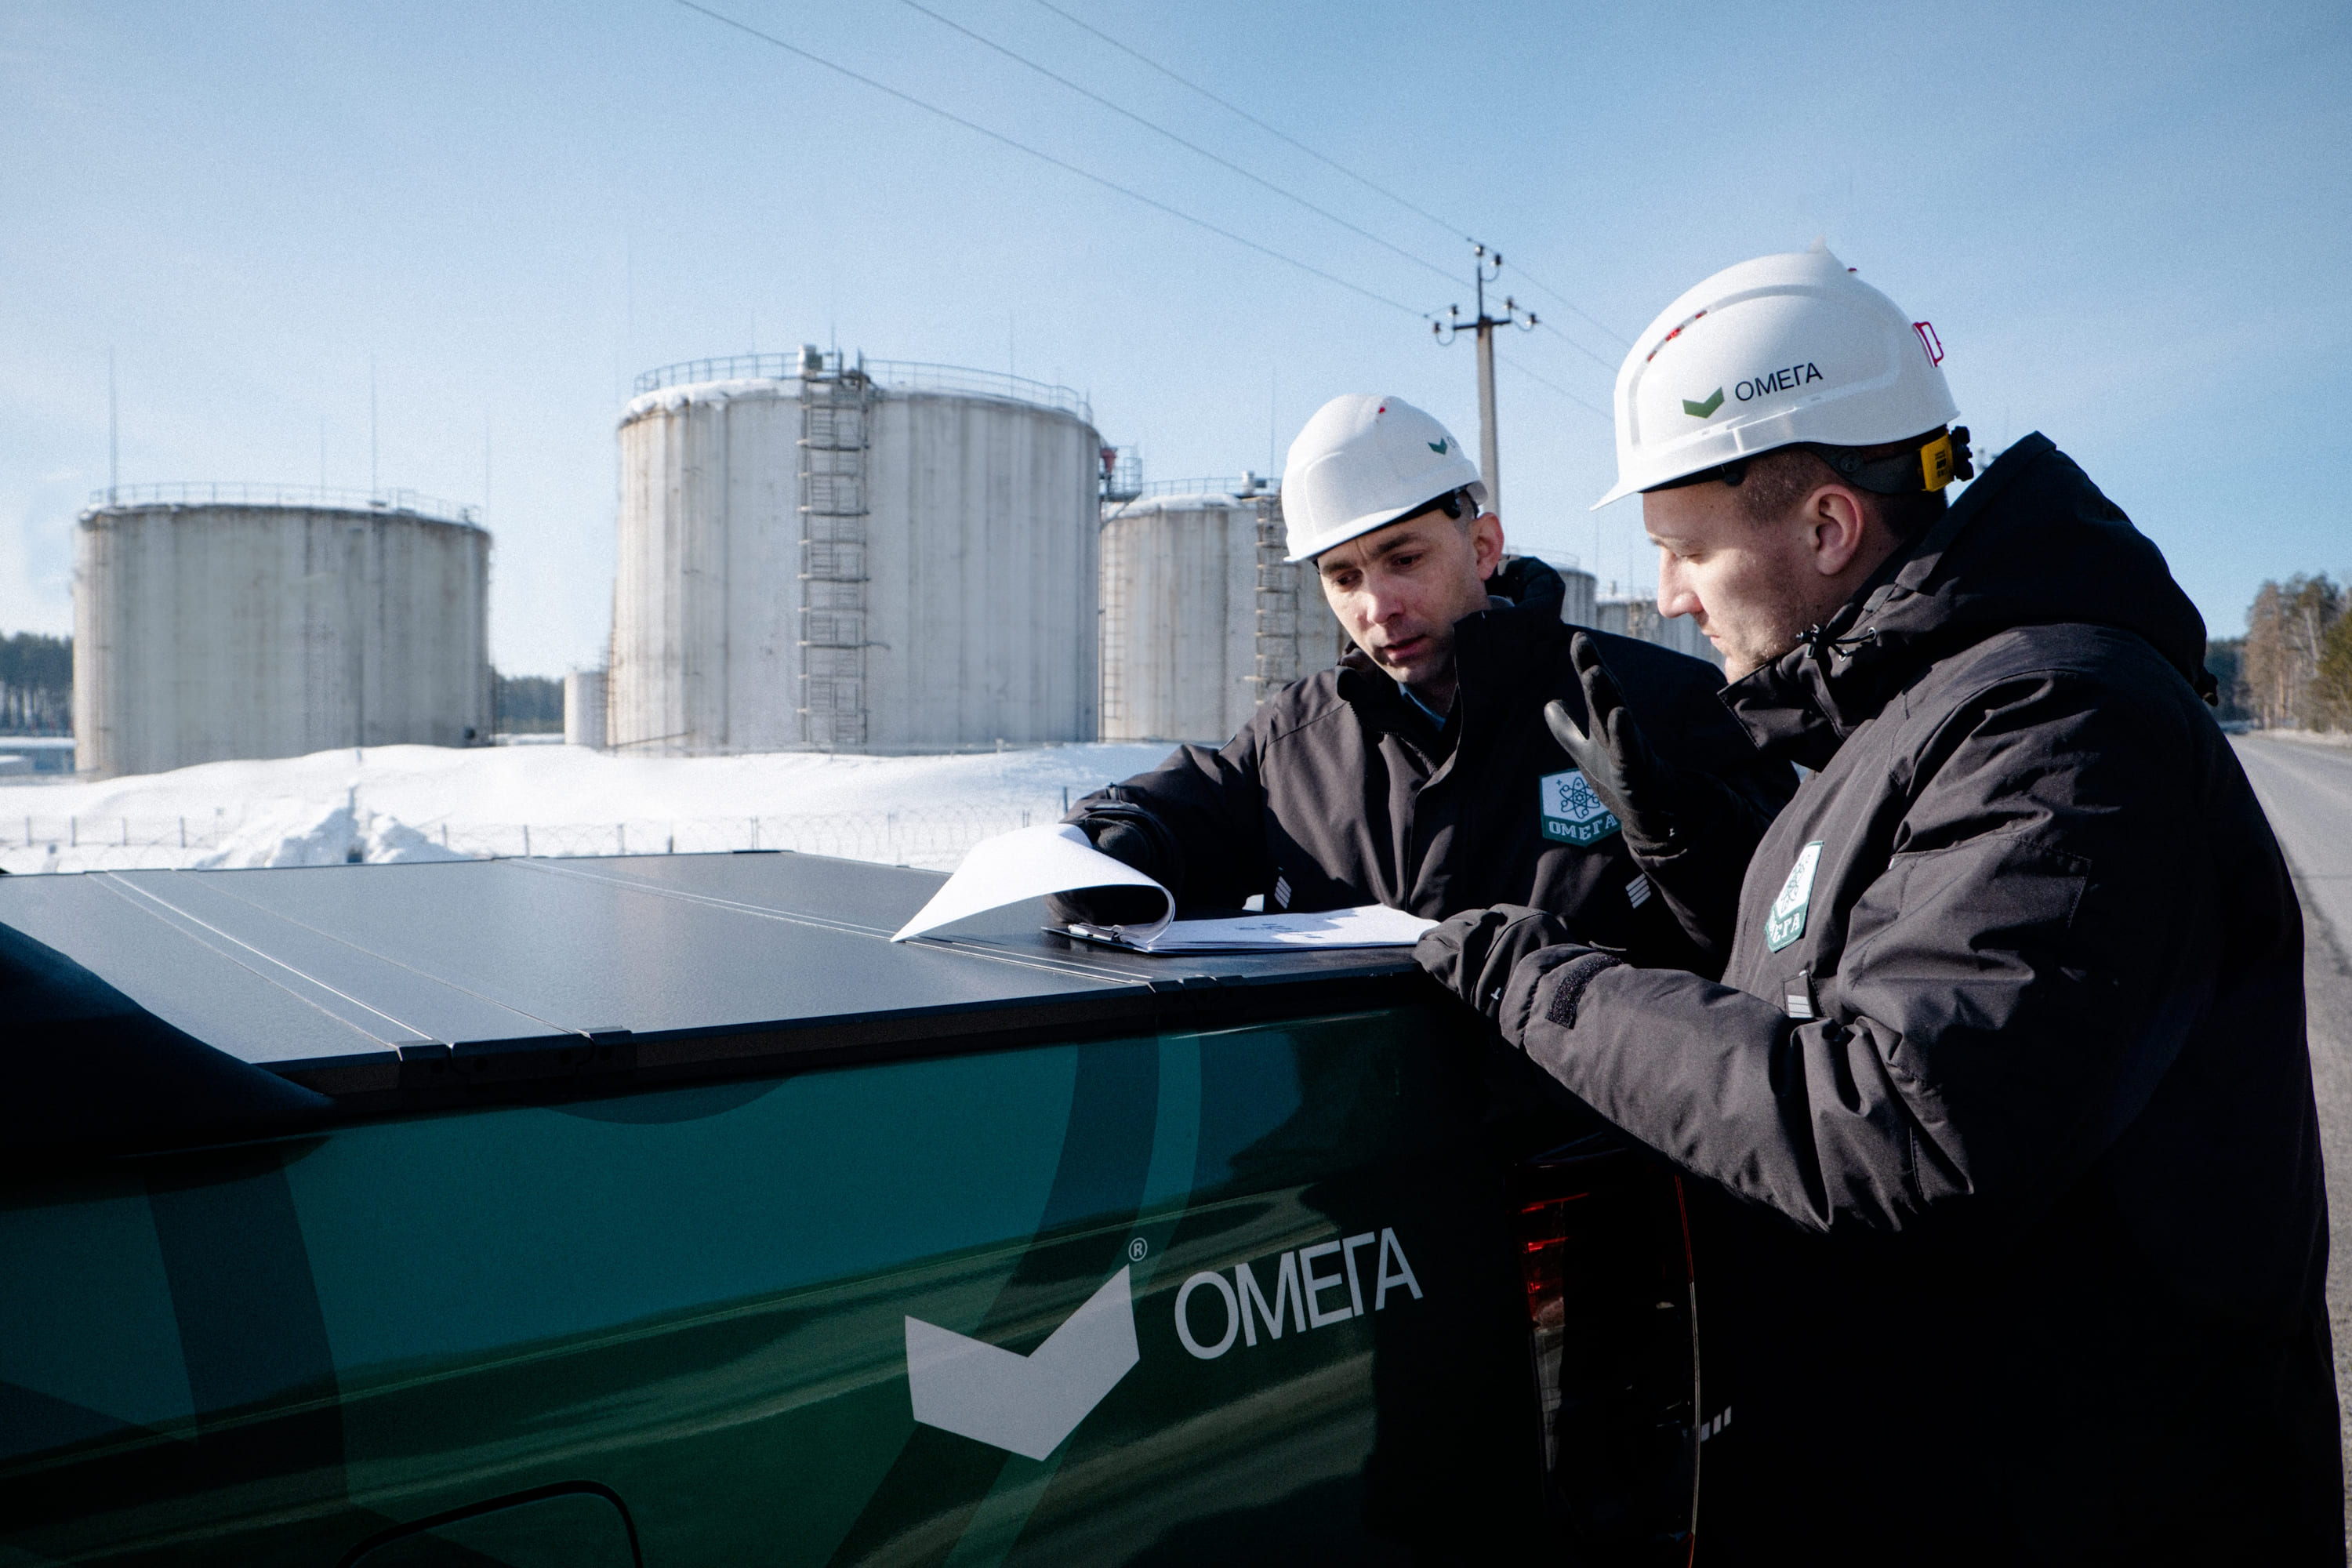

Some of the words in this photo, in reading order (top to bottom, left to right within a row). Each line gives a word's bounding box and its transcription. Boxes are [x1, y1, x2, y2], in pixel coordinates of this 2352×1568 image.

[1734, 362, 1824, 401] ОМЕГА
[1548, 814, 1618, 840] ОМЕГА
[1174, 1227, 1424, 1360] ОМЕГА
